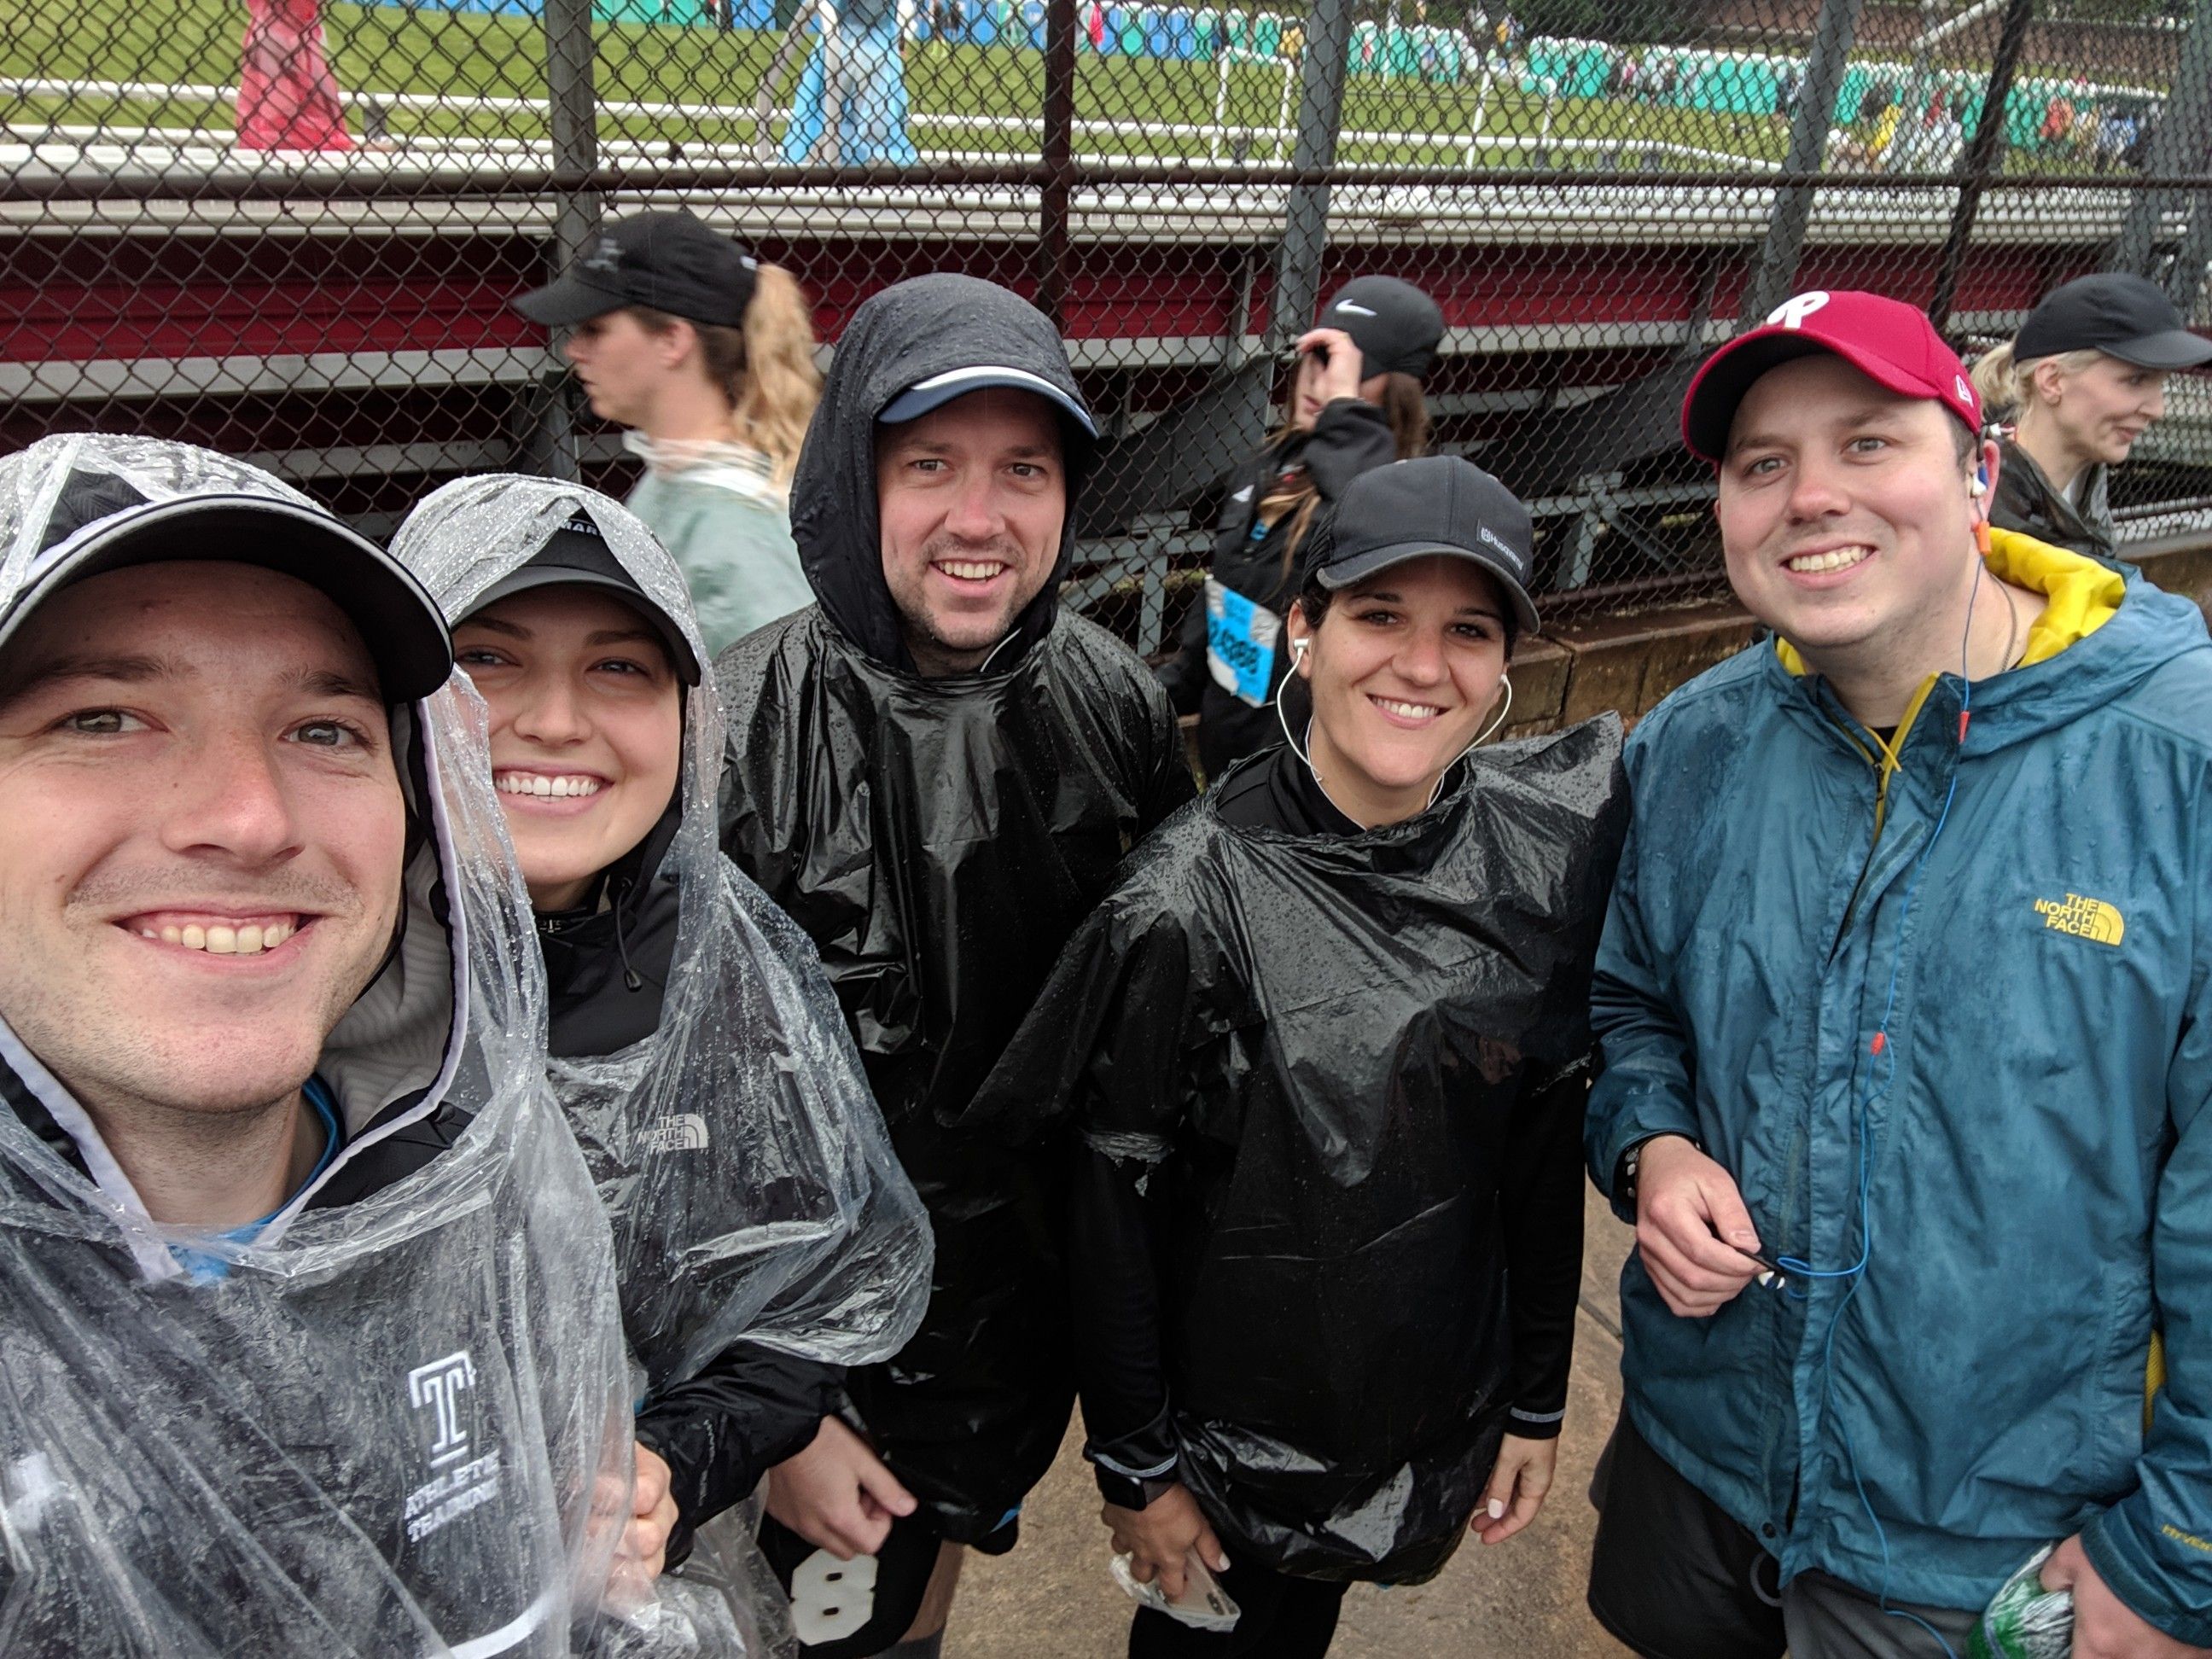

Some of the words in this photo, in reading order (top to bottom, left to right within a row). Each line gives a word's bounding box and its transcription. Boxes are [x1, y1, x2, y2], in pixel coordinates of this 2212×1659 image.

[2034, 898, 2097, 928] NORTH
[2065, 892, 2099, 913] THE
[2045, 915, 2092, 939] FACE
[658, 1114, 685, 1128] THE
[637, 1124, 684, 1145] NORTH
[649, 1138, 685, 1155] FACE
[408, 1350, 477, 1469] T
